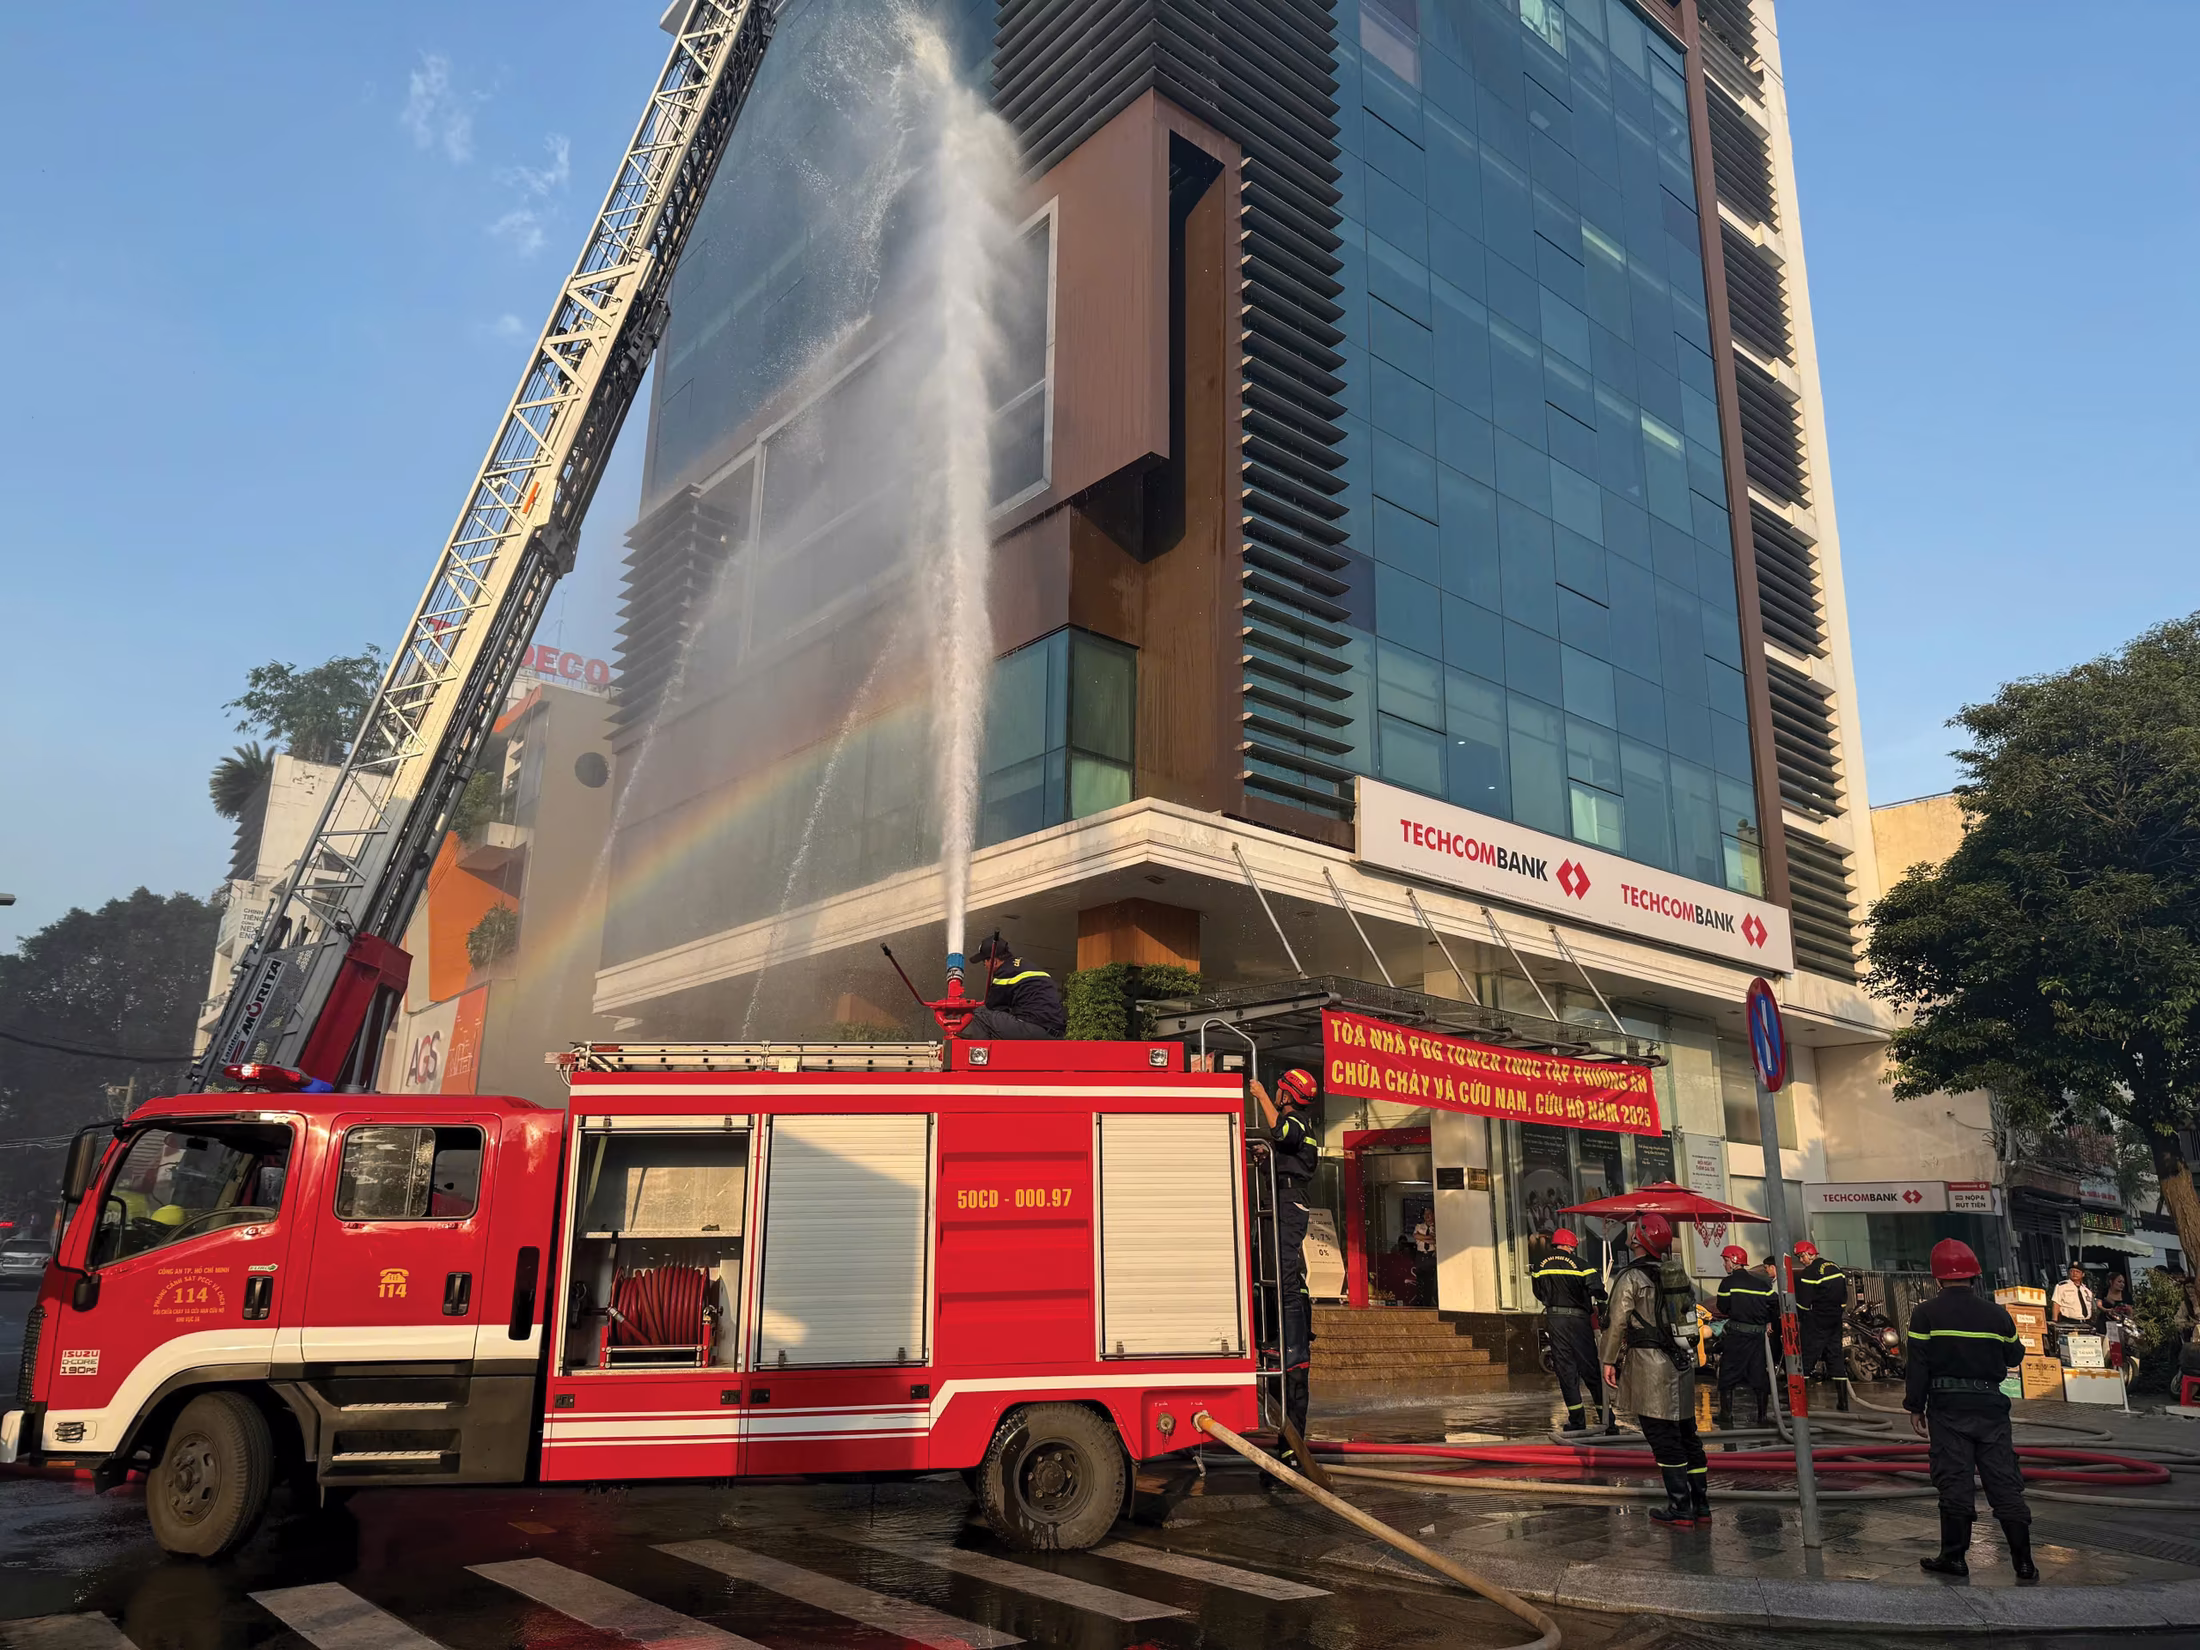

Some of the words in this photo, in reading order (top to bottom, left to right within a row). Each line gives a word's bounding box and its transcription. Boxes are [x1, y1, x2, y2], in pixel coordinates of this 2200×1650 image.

[1400, 818, 1548, 882] TECHCOMBANK
[1621, 883, 1736, 934] TECHCOMBANK
[241, 960, 282, 1037] MORITA
[405, 1030, 441, 1088] AGS
[1331, 1017, 1366, 1047] TÒA
[1369, 1027, 1407, 1055] NHÀ
[1446, 1043, 1501, 1072] TOWER
[1504, 1055, 1541, 1081] THỰC
[1544, 1059, 1571, 1086] TẬP
[1573, 1064, 1627, 1091] PHƯƠNG
[1629, 1070, 1648, 1093] ÁN
[1331, 1059, 1381, 1090] CHỮA
[1384, 1068, 1429, 1096] CHÁY
[1433, 1074, 1456, 1102] VÀ
[1458, 1078, 1491, 1107] CỨU
[1495, 1086, 1532, 1115] NẠN,
[1535, 1090, 1563, 1117] CỨU
[1566, 1095, 1585, 1123] HỘ
[1587, 1098, 1620, 1123] NĂM
[1620, 1105, 1652, 1127] 2025
[957, 1189, 999, 1209] 50CD
[1015, 1188, 1072, 1208] 000.97
[1823, 1193, 1898, 1203] TECHCOMBANK
[158, 1266, 174, 1275] CÔNG
[174, 1267, 183, 1275] AN
[184, 1267, 193, 1275] TP.
[198, 1276, 213, 1286] PCCC
[174, 1287, 208, 1304] 114
[378, 1283, 407, 1298] 114
